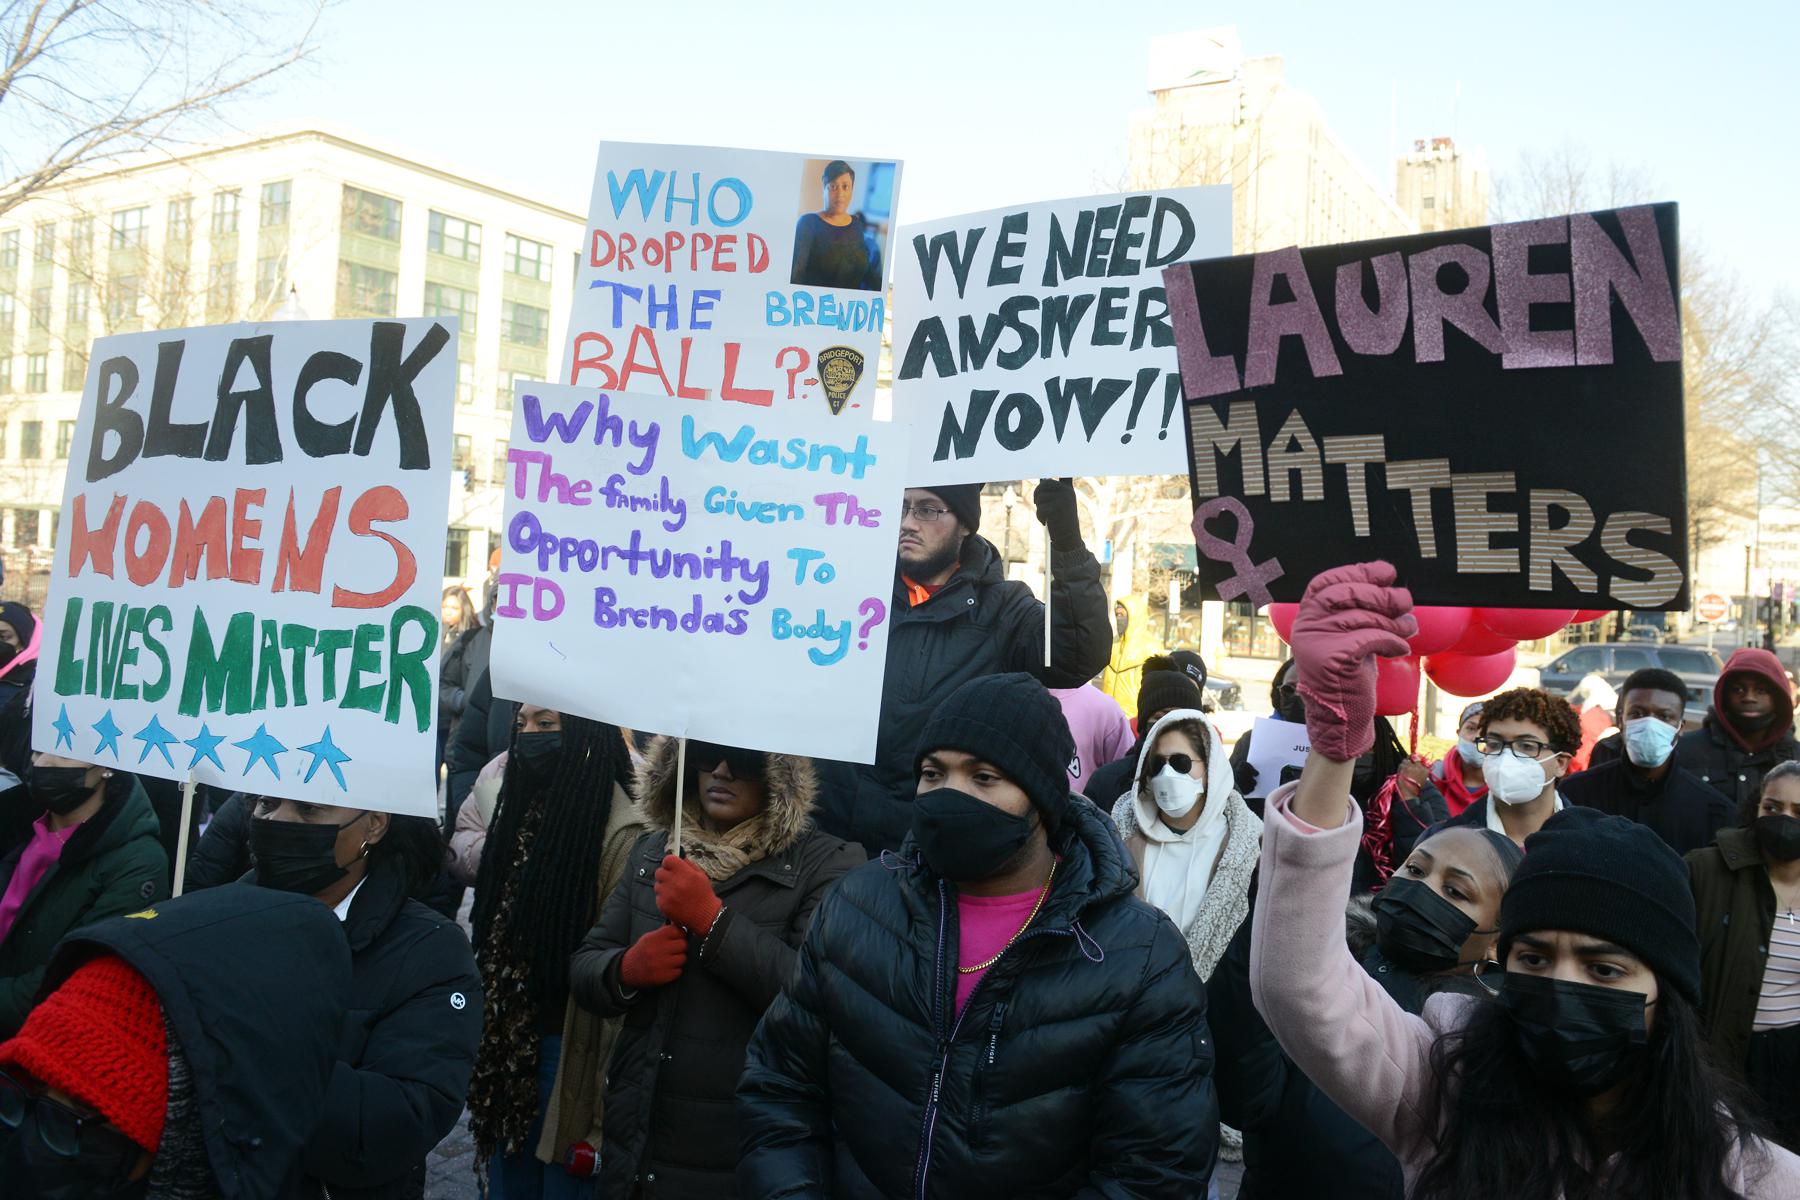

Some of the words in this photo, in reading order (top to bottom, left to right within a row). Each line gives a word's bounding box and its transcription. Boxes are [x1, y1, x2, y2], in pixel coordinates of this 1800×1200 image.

[607, 168, 754, 228] WHO
[590, 229, 771, 274] DROPPED
[912, 211, 1029, 301] WE
[1041, 195, 1196, 287] NEED
[589, 280, 722, 332] THE
[765, 291, 885, 333] BRENDA
[1161, 206, 1682, 400] LAUREN
[818, 349, 863, 366] BRIDGEPORT
[828, 391, 847, 399] POLICE
[86, 321, 451, 483] BLACK
[522, 393, 661, 476] Why
[681, 414, 877, 480] Wasnt
[832, 400, 840, 408] CT
[507, 448, 593, 506] The
[703, 485, 805, 524] Given
[813, 491, 882, 528] The
[1189, 400, 1684, 608] MATTERS
[68, 484, 418, 608] WOMENS
[508, 510, 769, 605] Opportunity
[786, 547, 836, 586] To
[496, 572, 566, 622] ID
[54, 596, 174, 703] LIVES
[178, 604, 439, 734] MATTER
